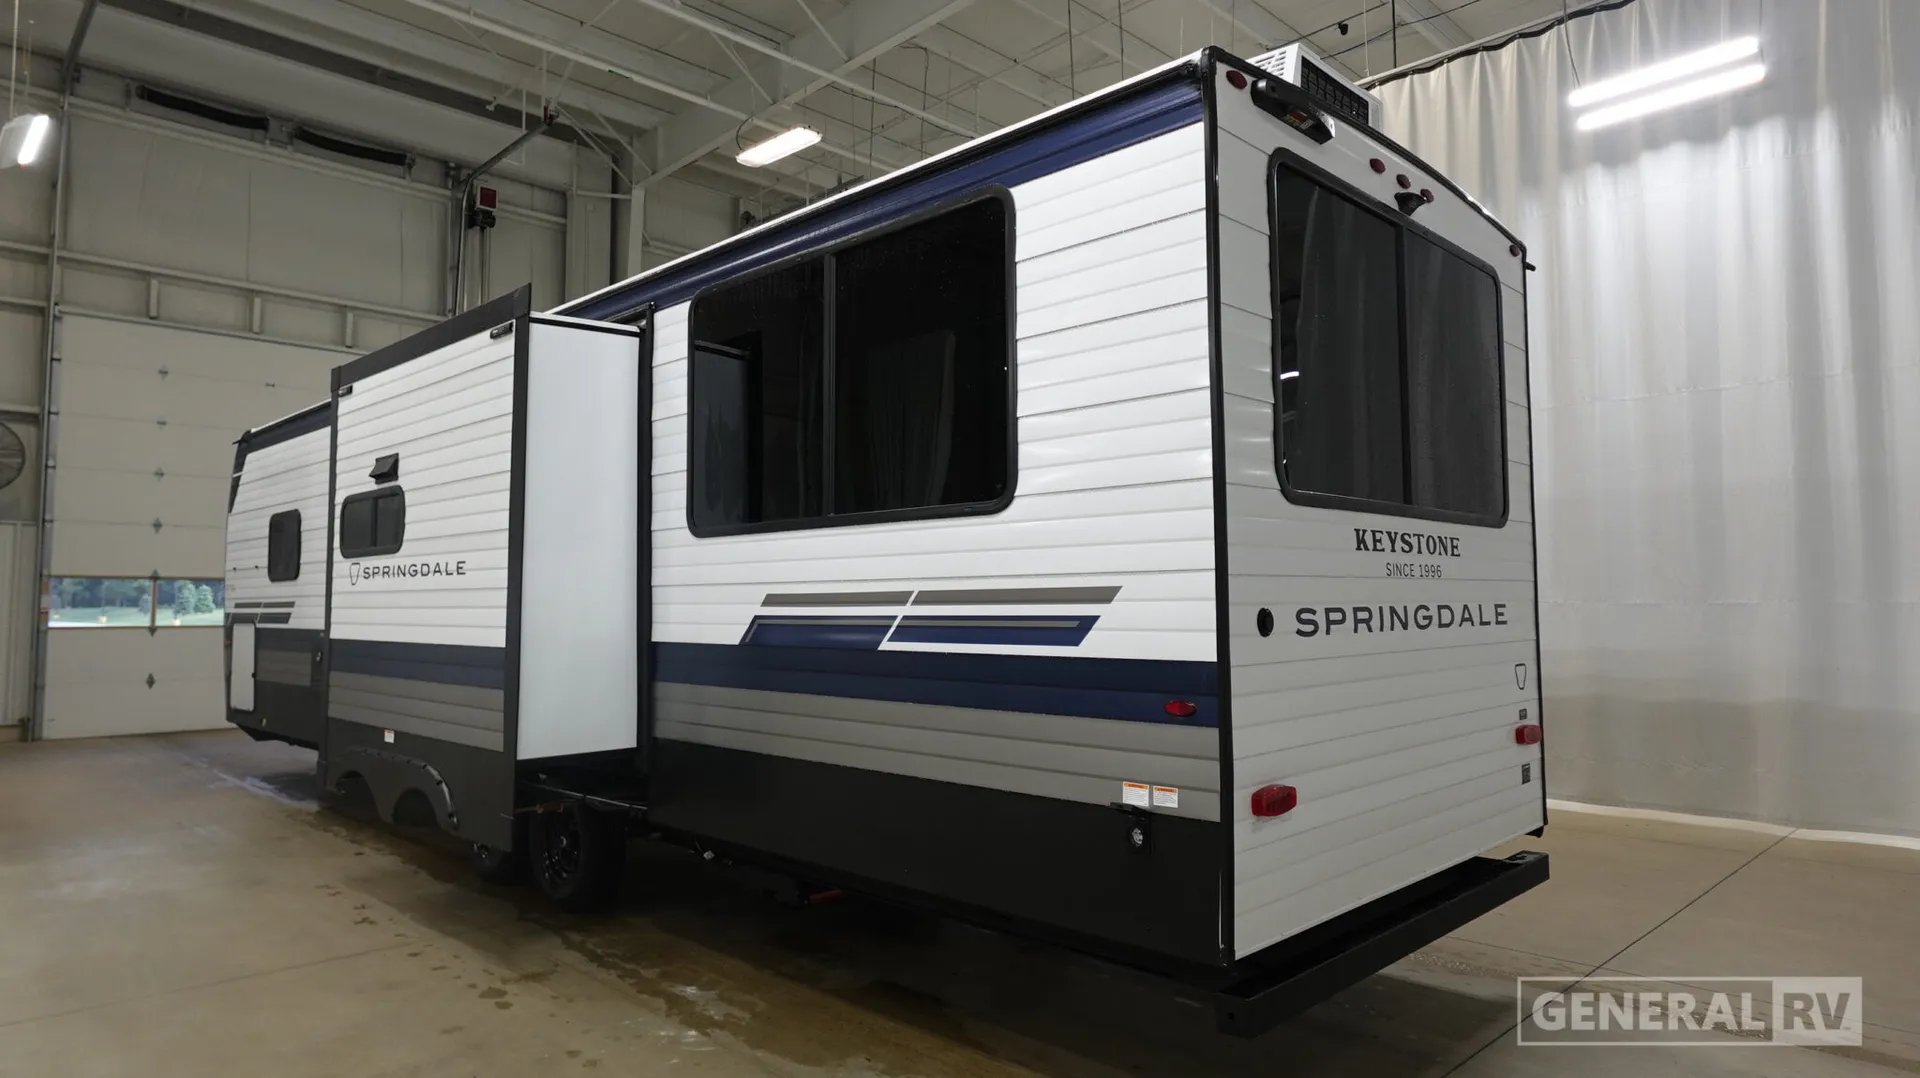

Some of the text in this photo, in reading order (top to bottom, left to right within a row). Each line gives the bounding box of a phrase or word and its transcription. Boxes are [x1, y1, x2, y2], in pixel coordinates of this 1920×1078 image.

[1354, 528, 1461, 557] KEYSTONE
[363, 561, 466, 579] SPRINGDALE
[1386, 562, 1443, 578] SINCE 1996
[1295, 603, 1508, 638] SPRINGDALE
